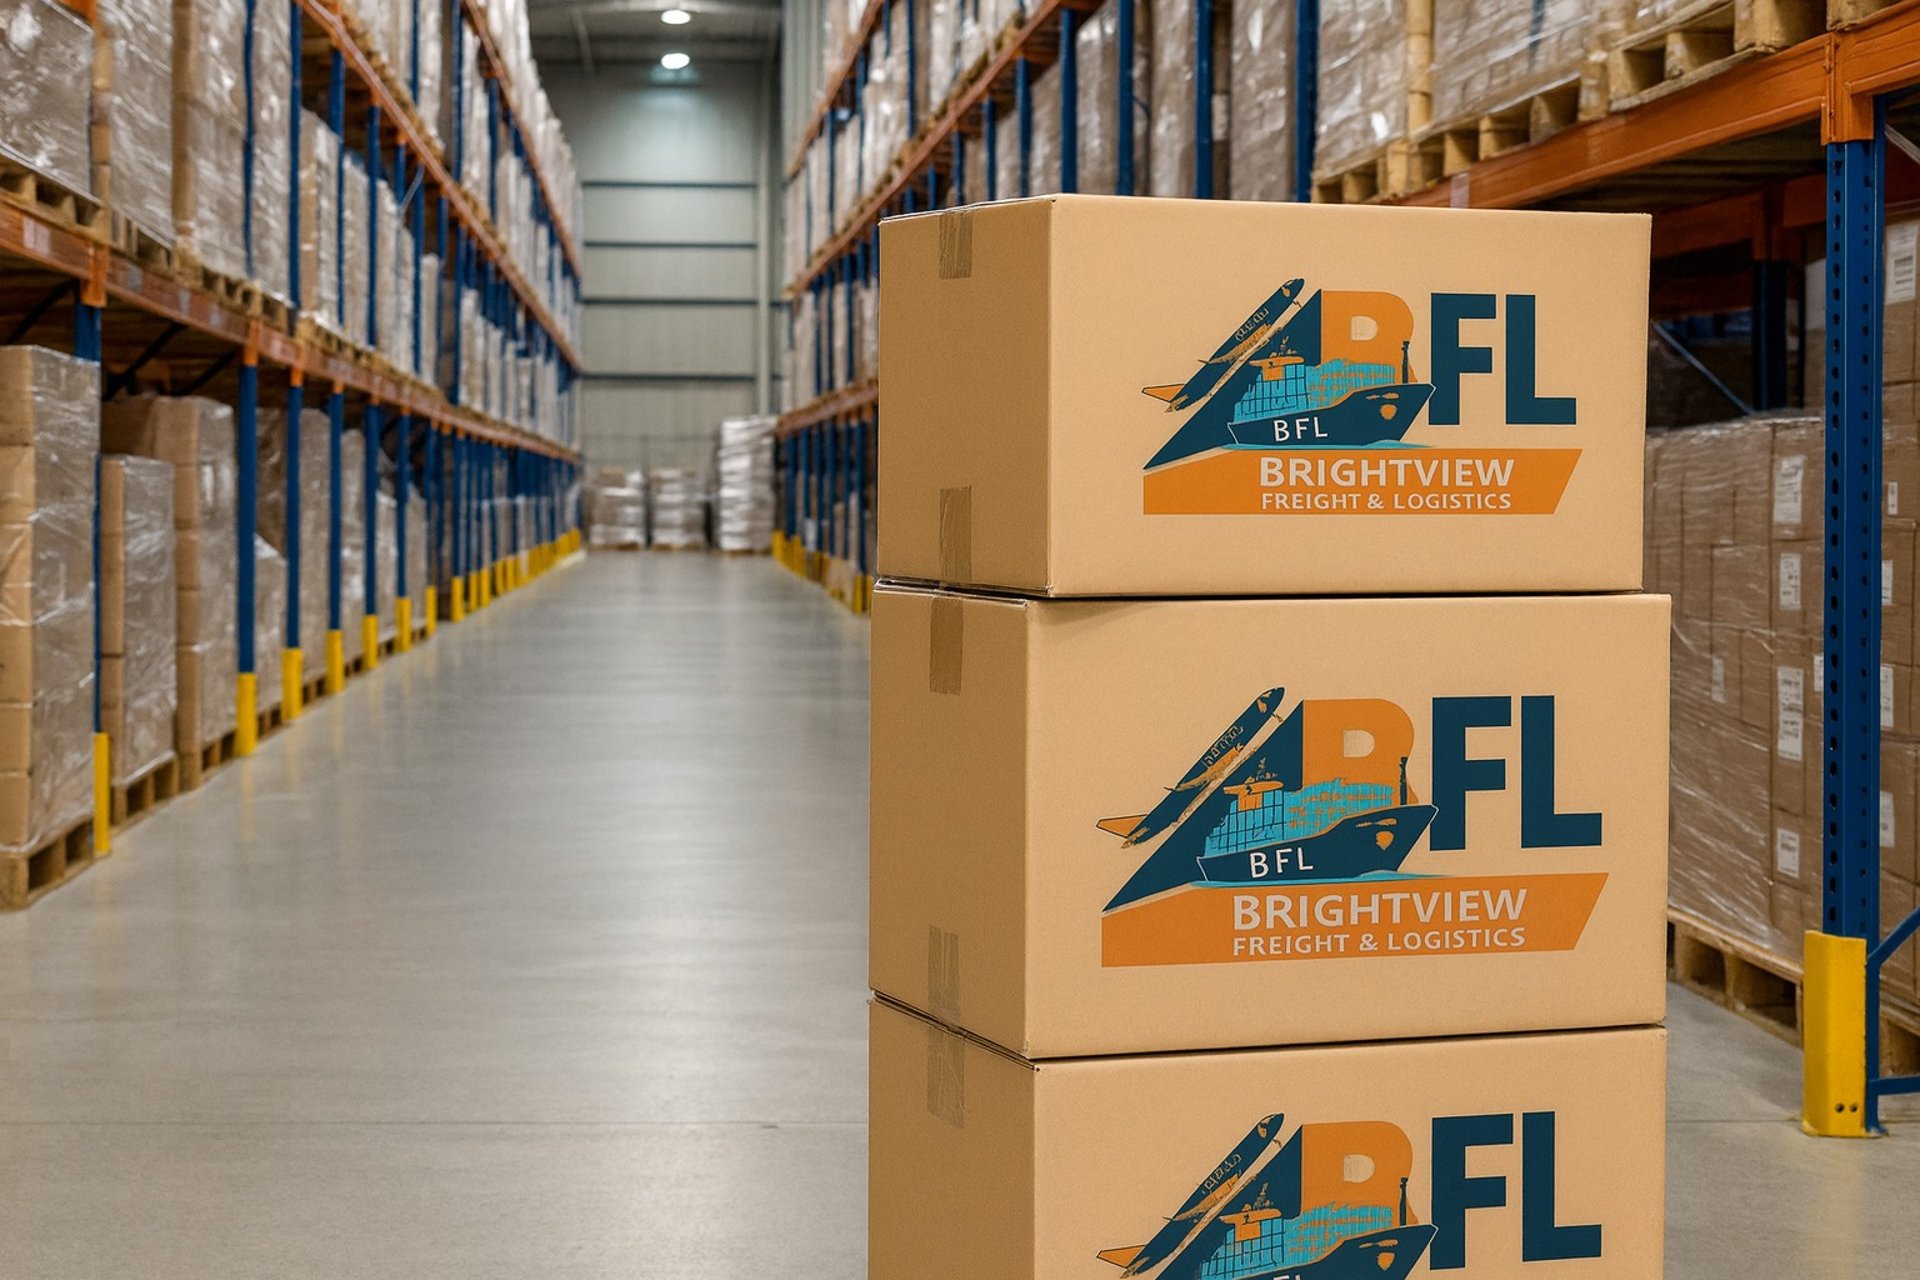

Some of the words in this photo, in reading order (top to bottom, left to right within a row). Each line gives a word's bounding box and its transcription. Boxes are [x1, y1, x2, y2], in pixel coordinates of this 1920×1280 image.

[1273, 416, 1328, 442] BFL
[1260, 457, 1515, 487] BRIGHTVIEW
[1262, 493, 1361, 510] FREIGHT
[1367, 493, 1384, 510] &
[1394, 493, 1512, 510] LOGISTICS
[1250, 847, 1314, 878] BFL
[1233, 889, 1527, 931] BRIGHTVIEW
[1233, 934, 1349, 956] FREIGHT
[1359, 933, 1378, 951] &
[1388, 927, 1526, 951] LOGISTICS
